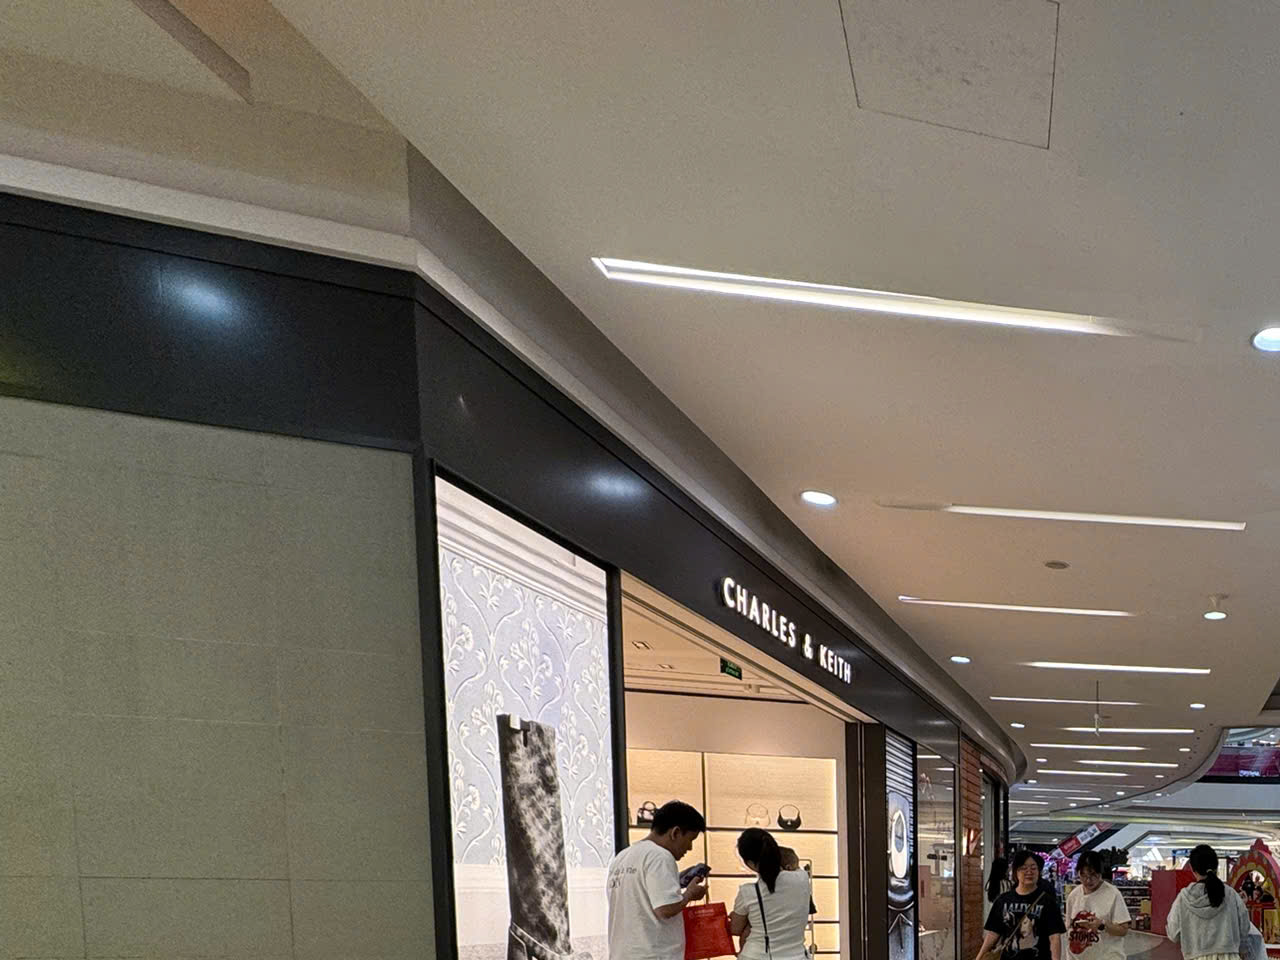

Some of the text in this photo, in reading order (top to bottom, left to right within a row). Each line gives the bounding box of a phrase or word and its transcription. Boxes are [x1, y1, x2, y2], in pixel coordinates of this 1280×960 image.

[723, 577, 852, 683] CHARLES & KEITH
